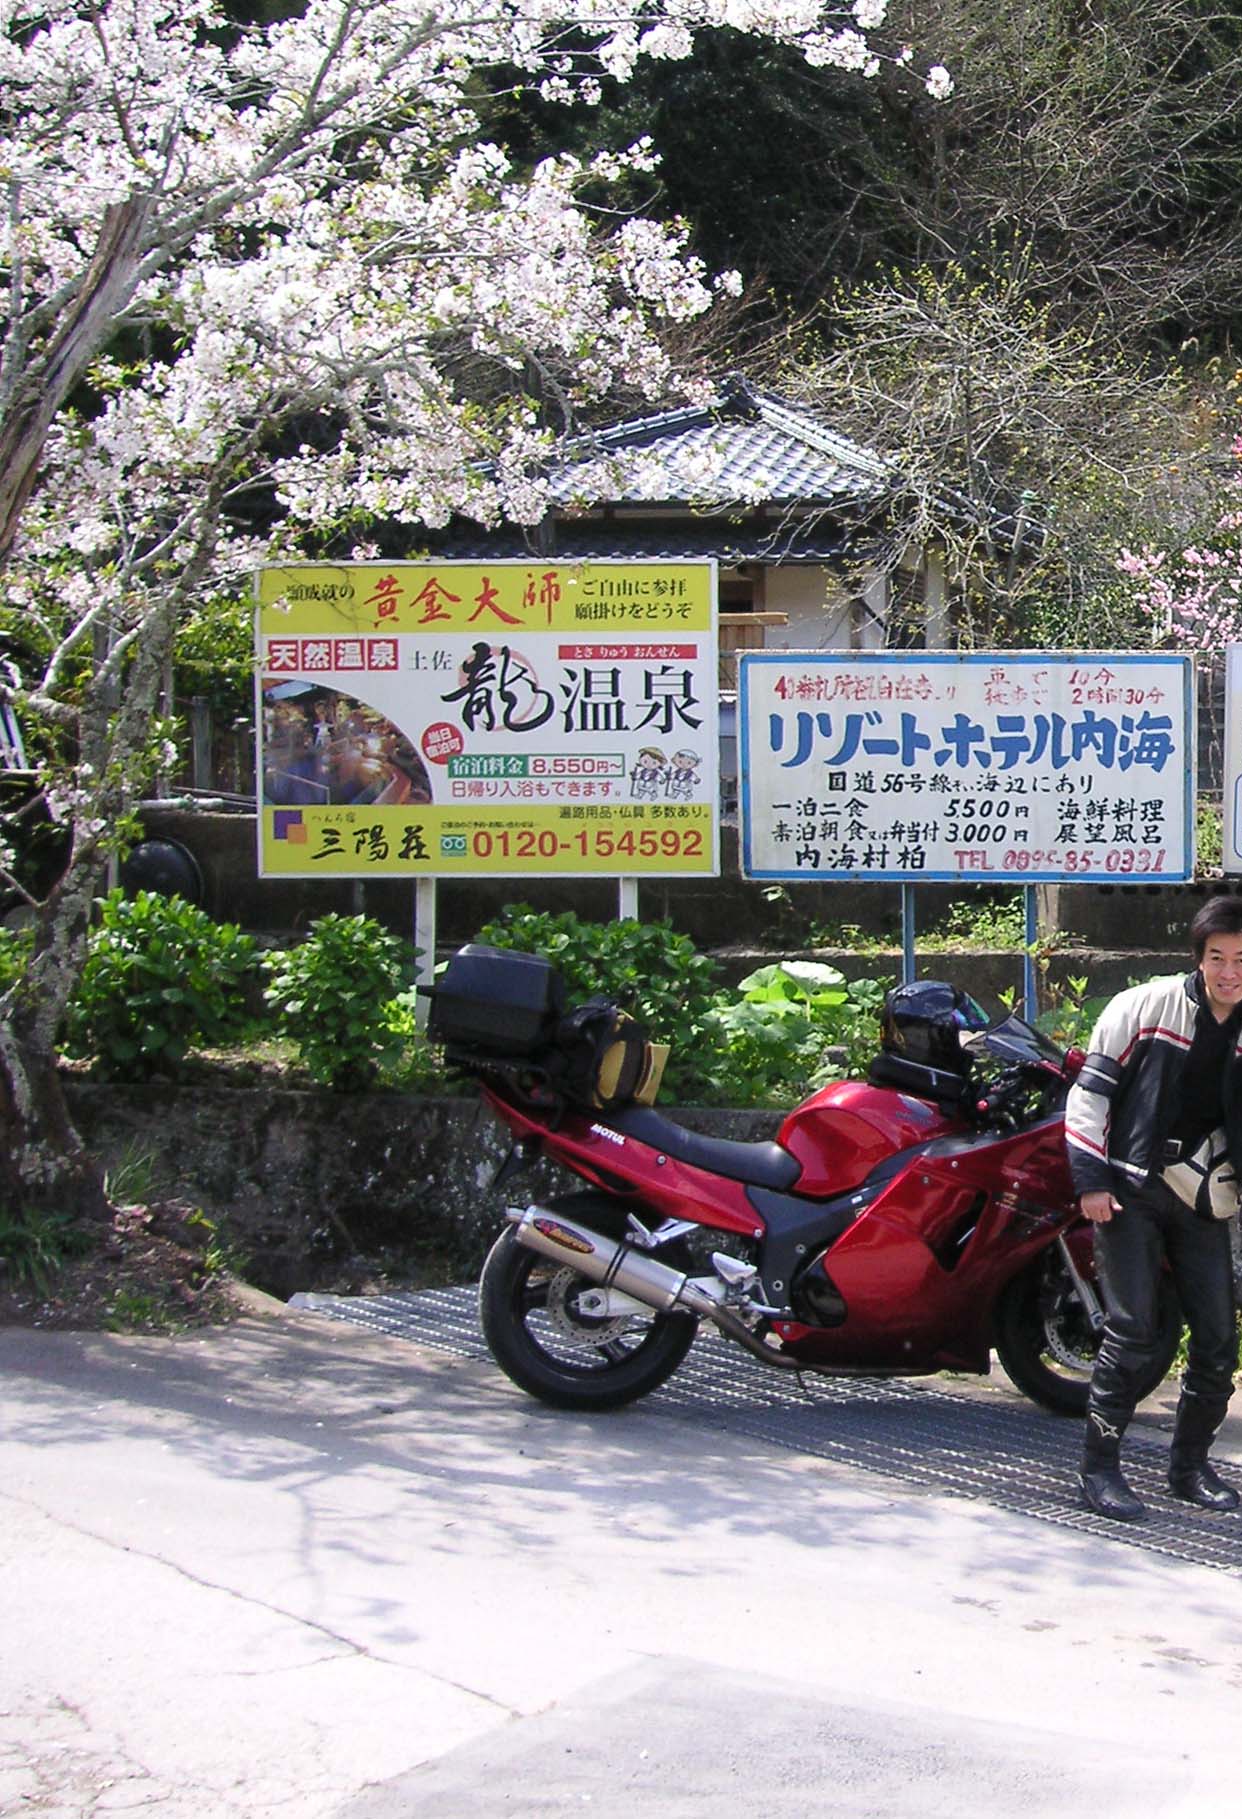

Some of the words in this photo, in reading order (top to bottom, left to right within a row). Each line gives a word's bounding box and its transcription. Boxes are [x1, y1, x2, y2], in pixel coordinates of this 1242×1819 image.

[581, 578, 687, 597] ご自由に参拝
[363, 572, 561, 628] 黄金大師
[574, 601, 694, 620] 願掛けをどうぞ
[270, 641, 396, 670] 天然温泉
[408, 650, 453, 671] 土佐
[634, 646, 681, 658] おんせん
[427, 727, 452, 743] 当日
[769, 709, 1176, 773] リゾートホテル内海
[452, 757, 524, 776] 宿泊料金
[452, 780, 621, 798] 日帰り入浴もできます。
[772, 797, 869, 817] 一泊二食
[1057, 797, 1166, 822] 海鮮料理
[311, 824, 431, 862] 三陽荘
[472, 829, 704, 858] 0120-154592
[1054, 823, 1163, 844] 展望風呂
[795, 843, 927, 870] 内海村柏
[954, 849, 995, 870] TEL
[591, 1123, 625, 1145] MOTUL
